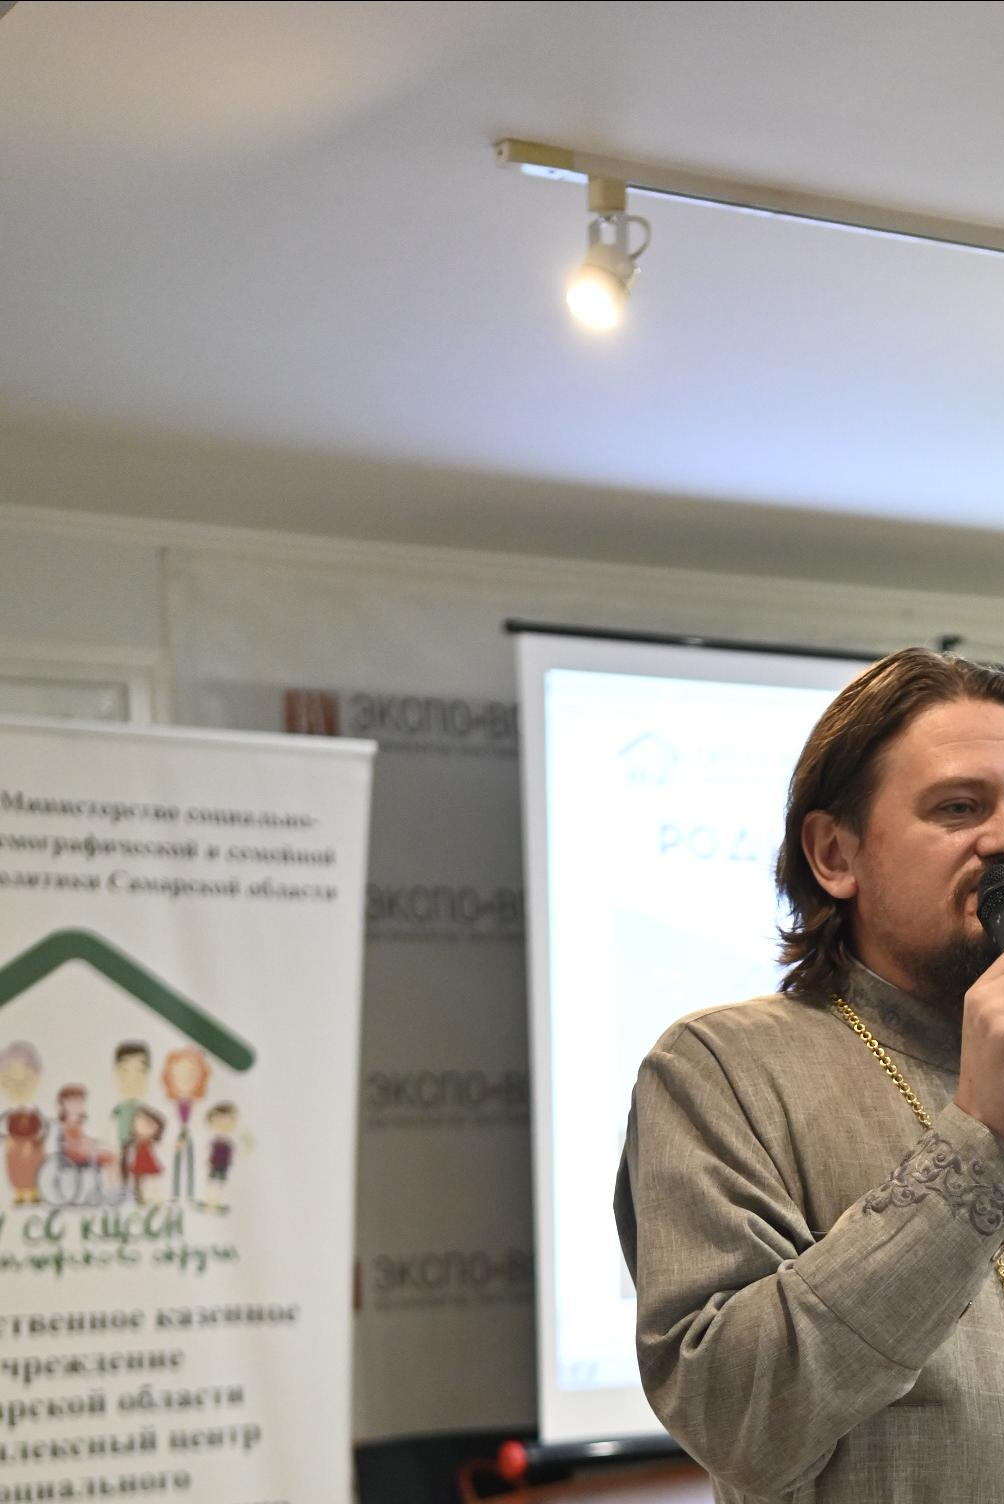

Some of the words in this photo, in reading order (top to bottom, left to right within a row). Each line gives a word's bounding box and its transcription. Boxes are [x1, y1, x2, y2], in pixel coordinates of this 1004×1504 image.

[656, 821, 773, 862] РОД
[107, 868, 240, 900] Самарской
[245, 876, 337, 900] области
[156, 1303, 298, 1328] казенное
[118, 1383, 243, 1411] области
[169, 1423, 261, 1453] центр
